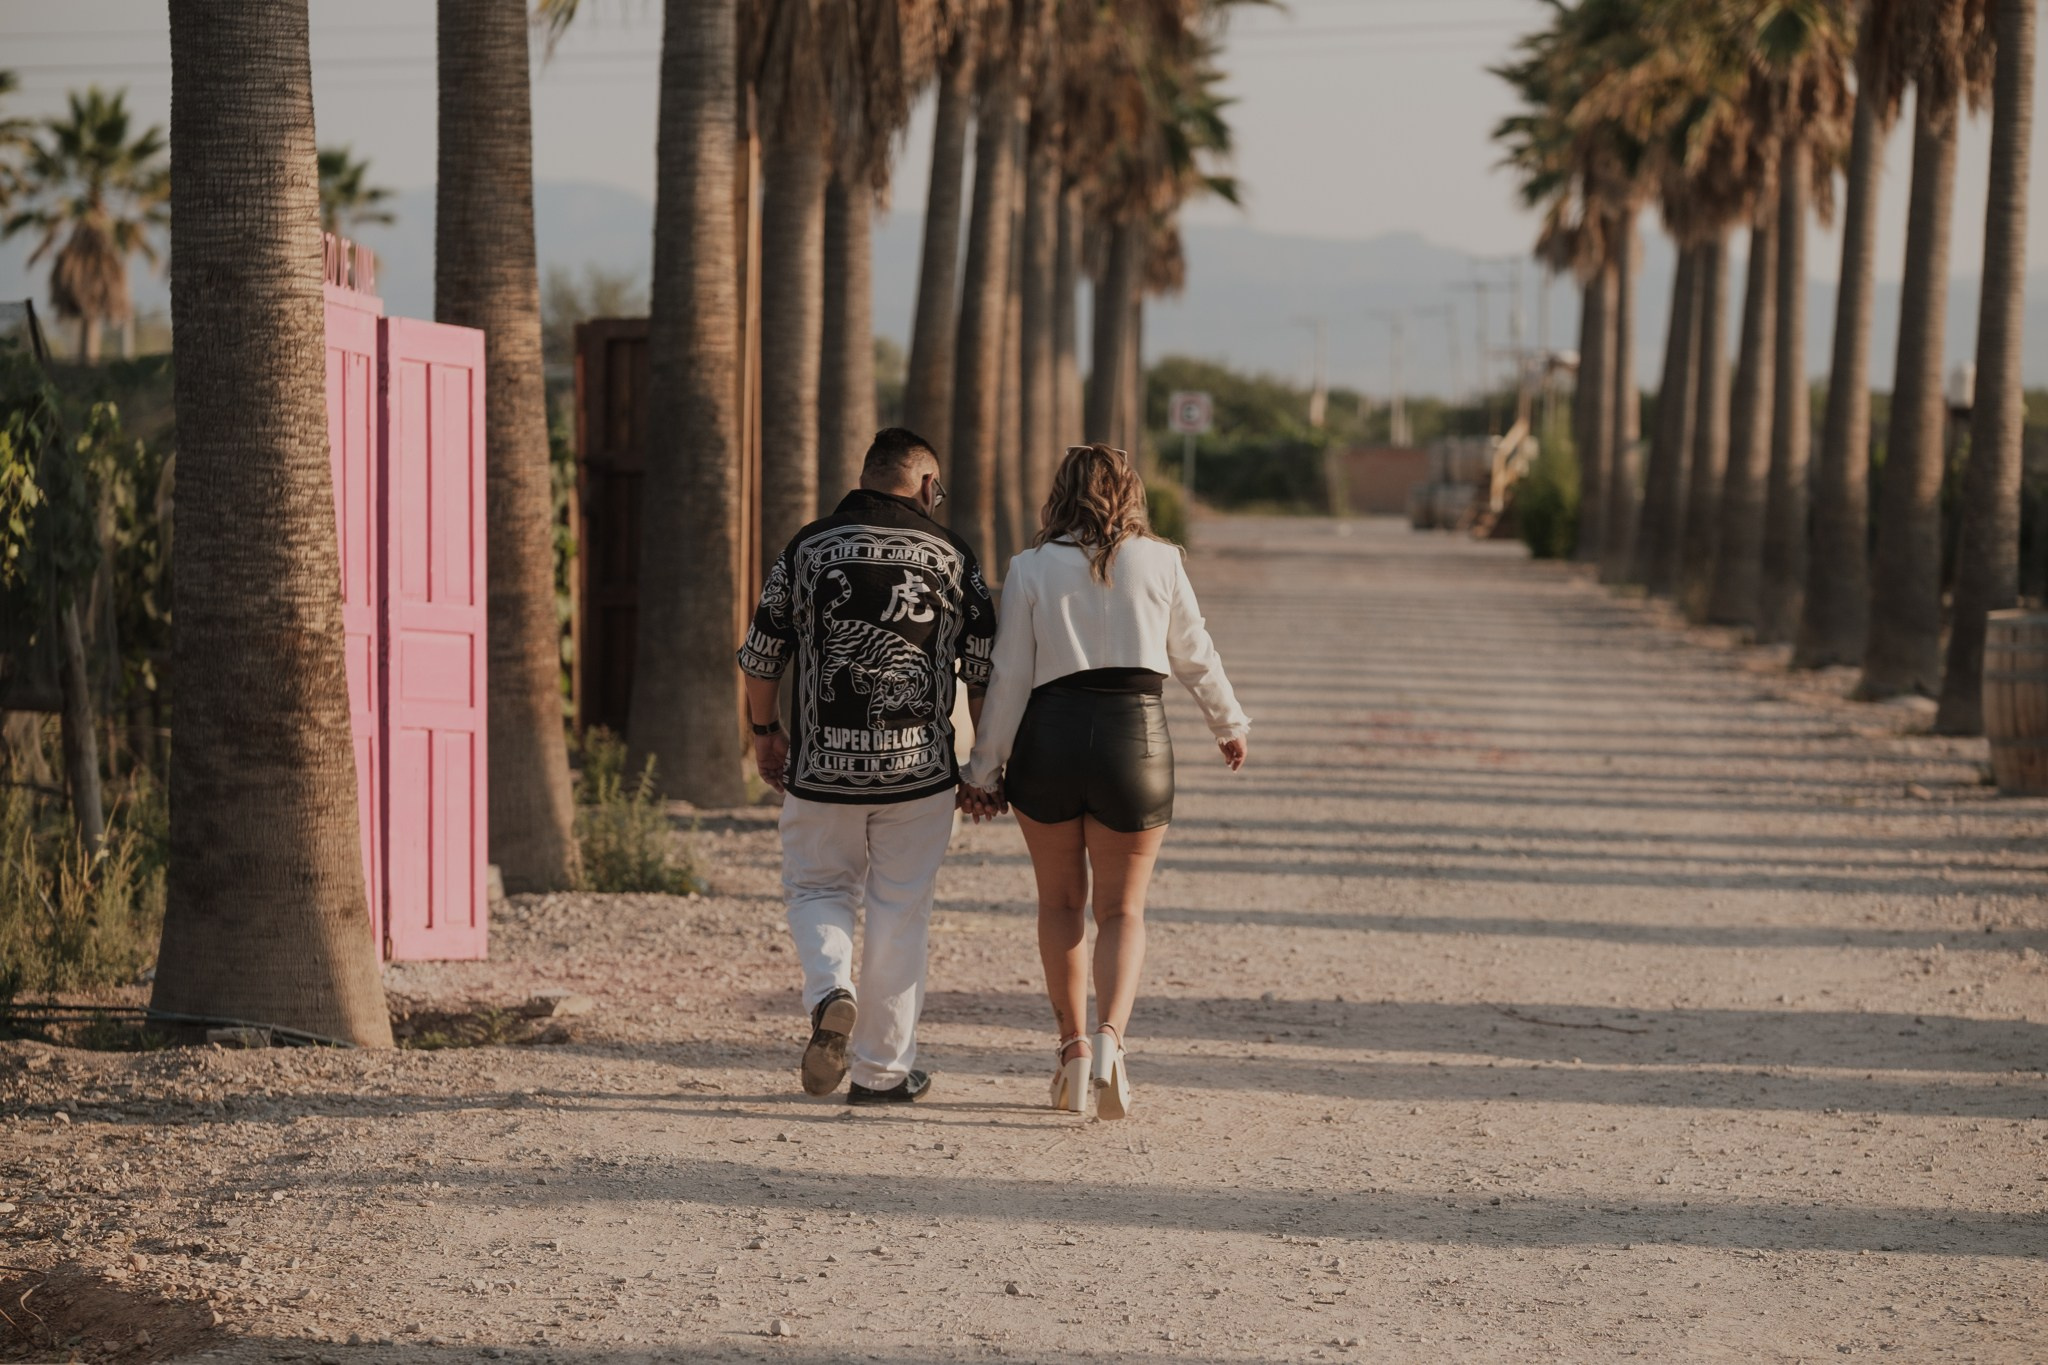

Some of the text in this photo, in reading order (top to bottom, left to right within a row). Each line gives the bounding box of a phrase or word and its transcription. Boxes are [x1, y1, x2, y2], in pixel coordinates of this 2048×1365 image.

[830, 546, 929, 564] LIFE IN JAPAN
[879, 569, 935, 623] 虎
[823, 725, 929, 752] SUPER DELUXE
[824, 751, 928, 771] LIFE IN JAPAN
